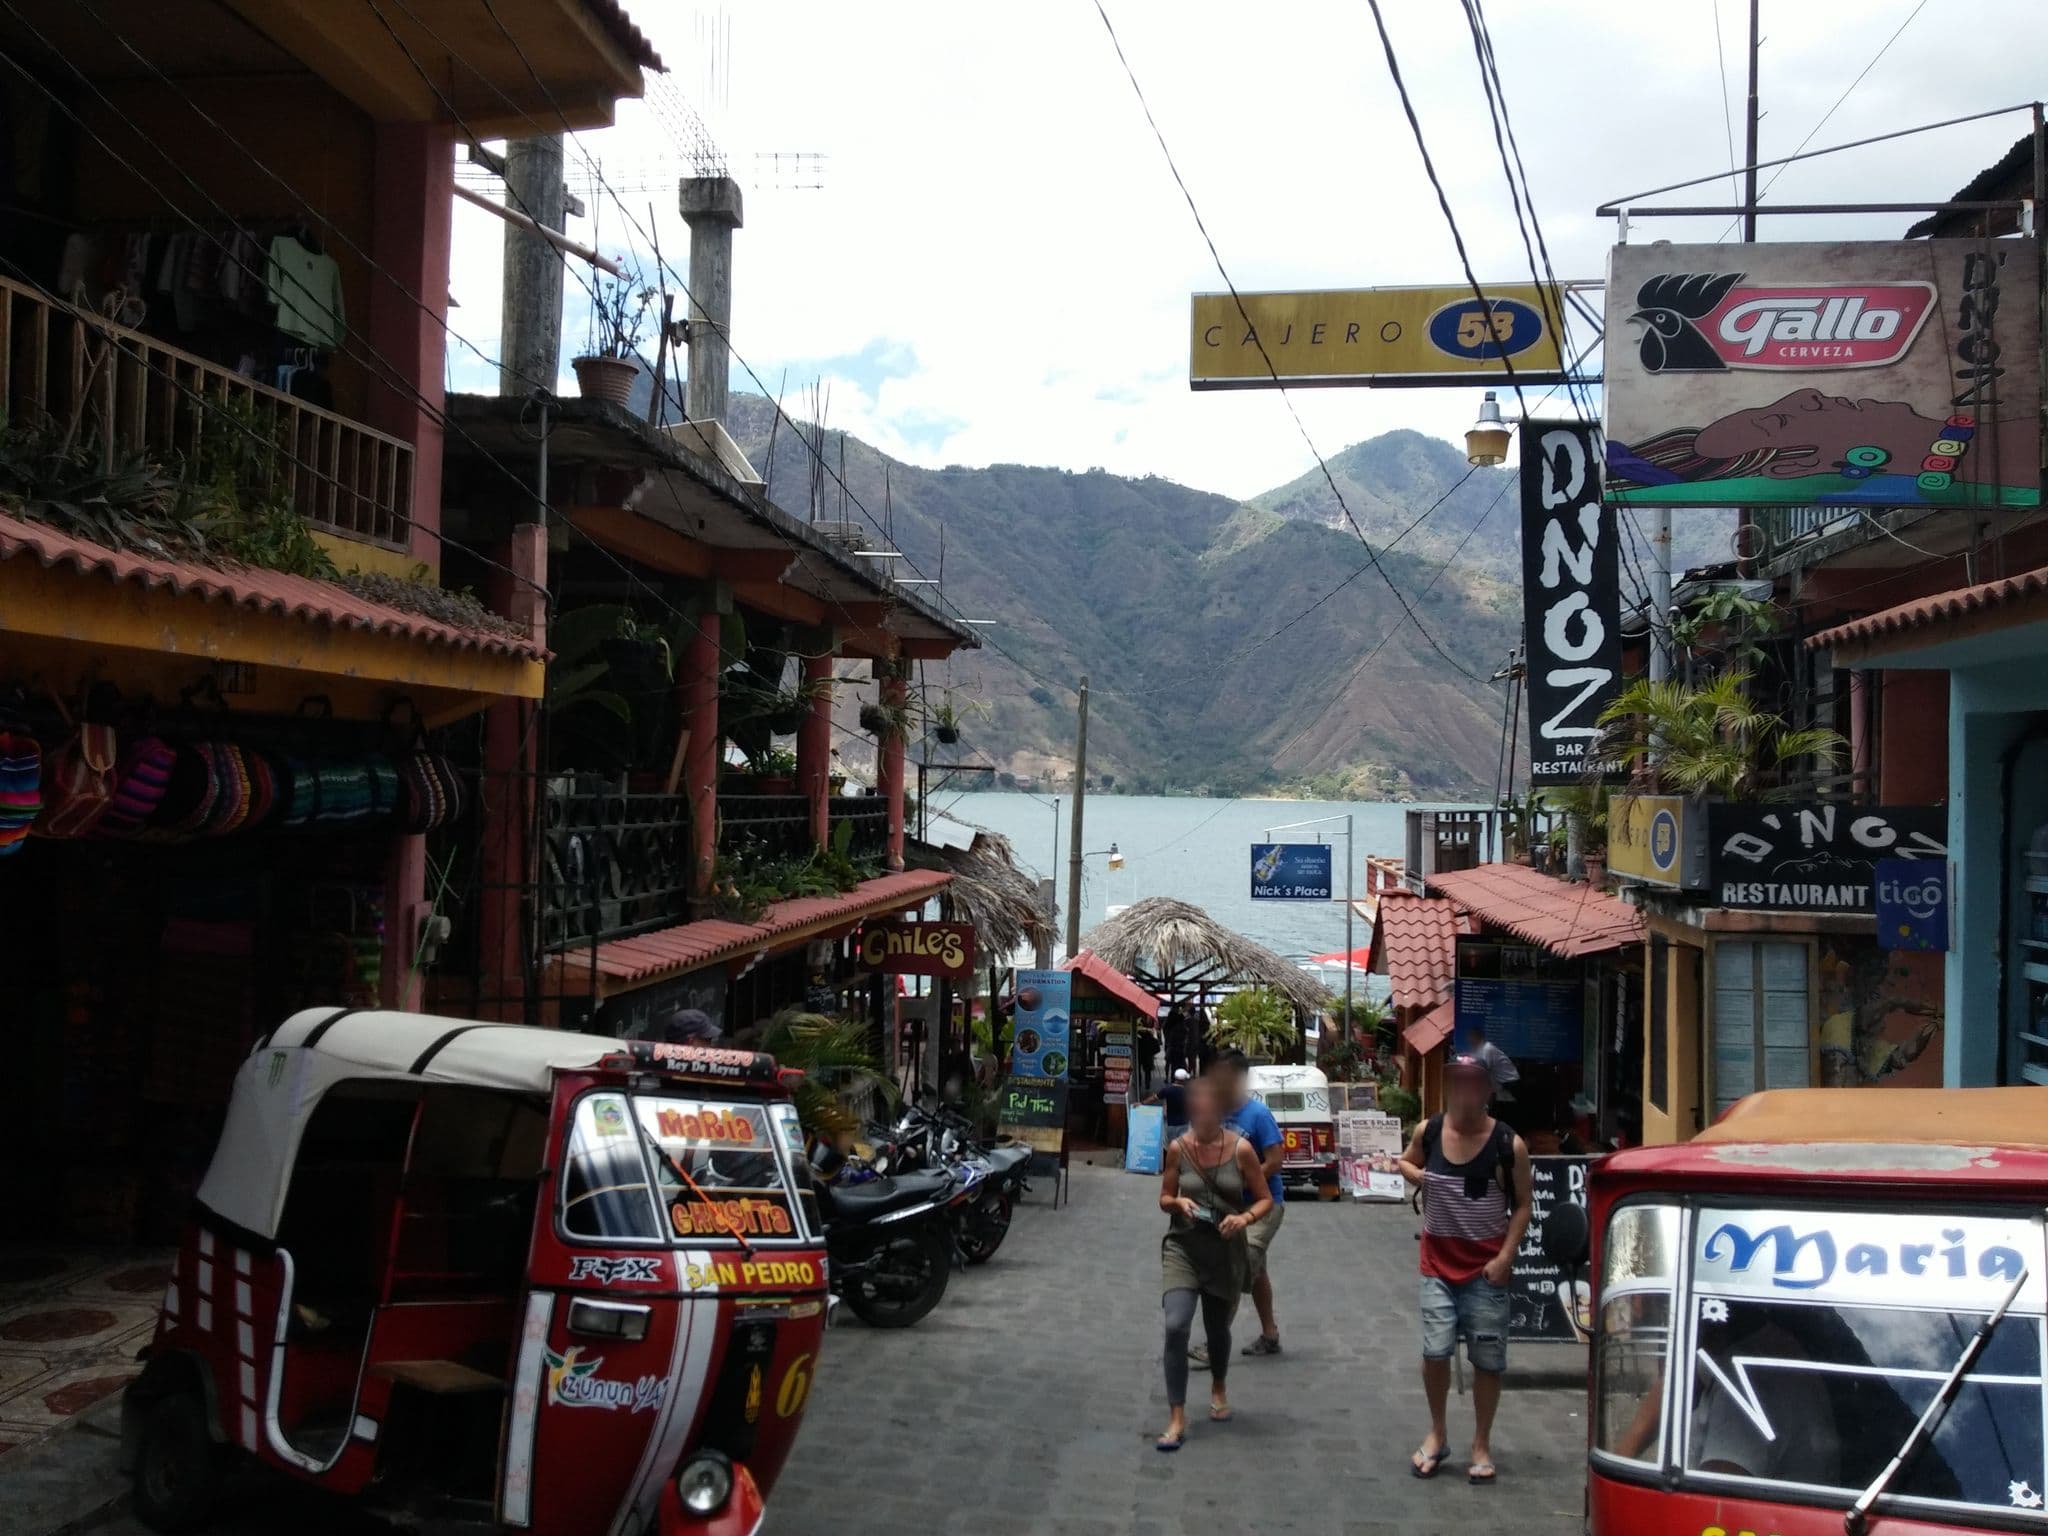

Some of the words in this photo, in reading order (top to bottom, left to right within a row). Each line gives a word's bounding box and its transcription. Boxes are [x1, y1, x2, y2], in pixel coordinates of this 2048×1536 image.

[1204, 321, 1402, 347] CAJERO
[1778, 346, 1854, 358] CERVEZA
[1555, 743, 1585, 756] BAR
[1293, 885, 1328, 897] Place
[1721, 882, 1870, 907] RESTAURANT
[1021, 977, 1067, 986] INFORMATION
[667, 1058, 689, 1072] Rey
[709, 1062, 741, 1077] Reyes
[1376, 1119, 1399, 1127] PLACE
[1703, 1222, 2026, 1290] Maria
[686, 1262, 738, 1289] SAN
[741, 1260, 816, 1286] PEDRO
[1511, 1263, 1561, 1276] estaurant
